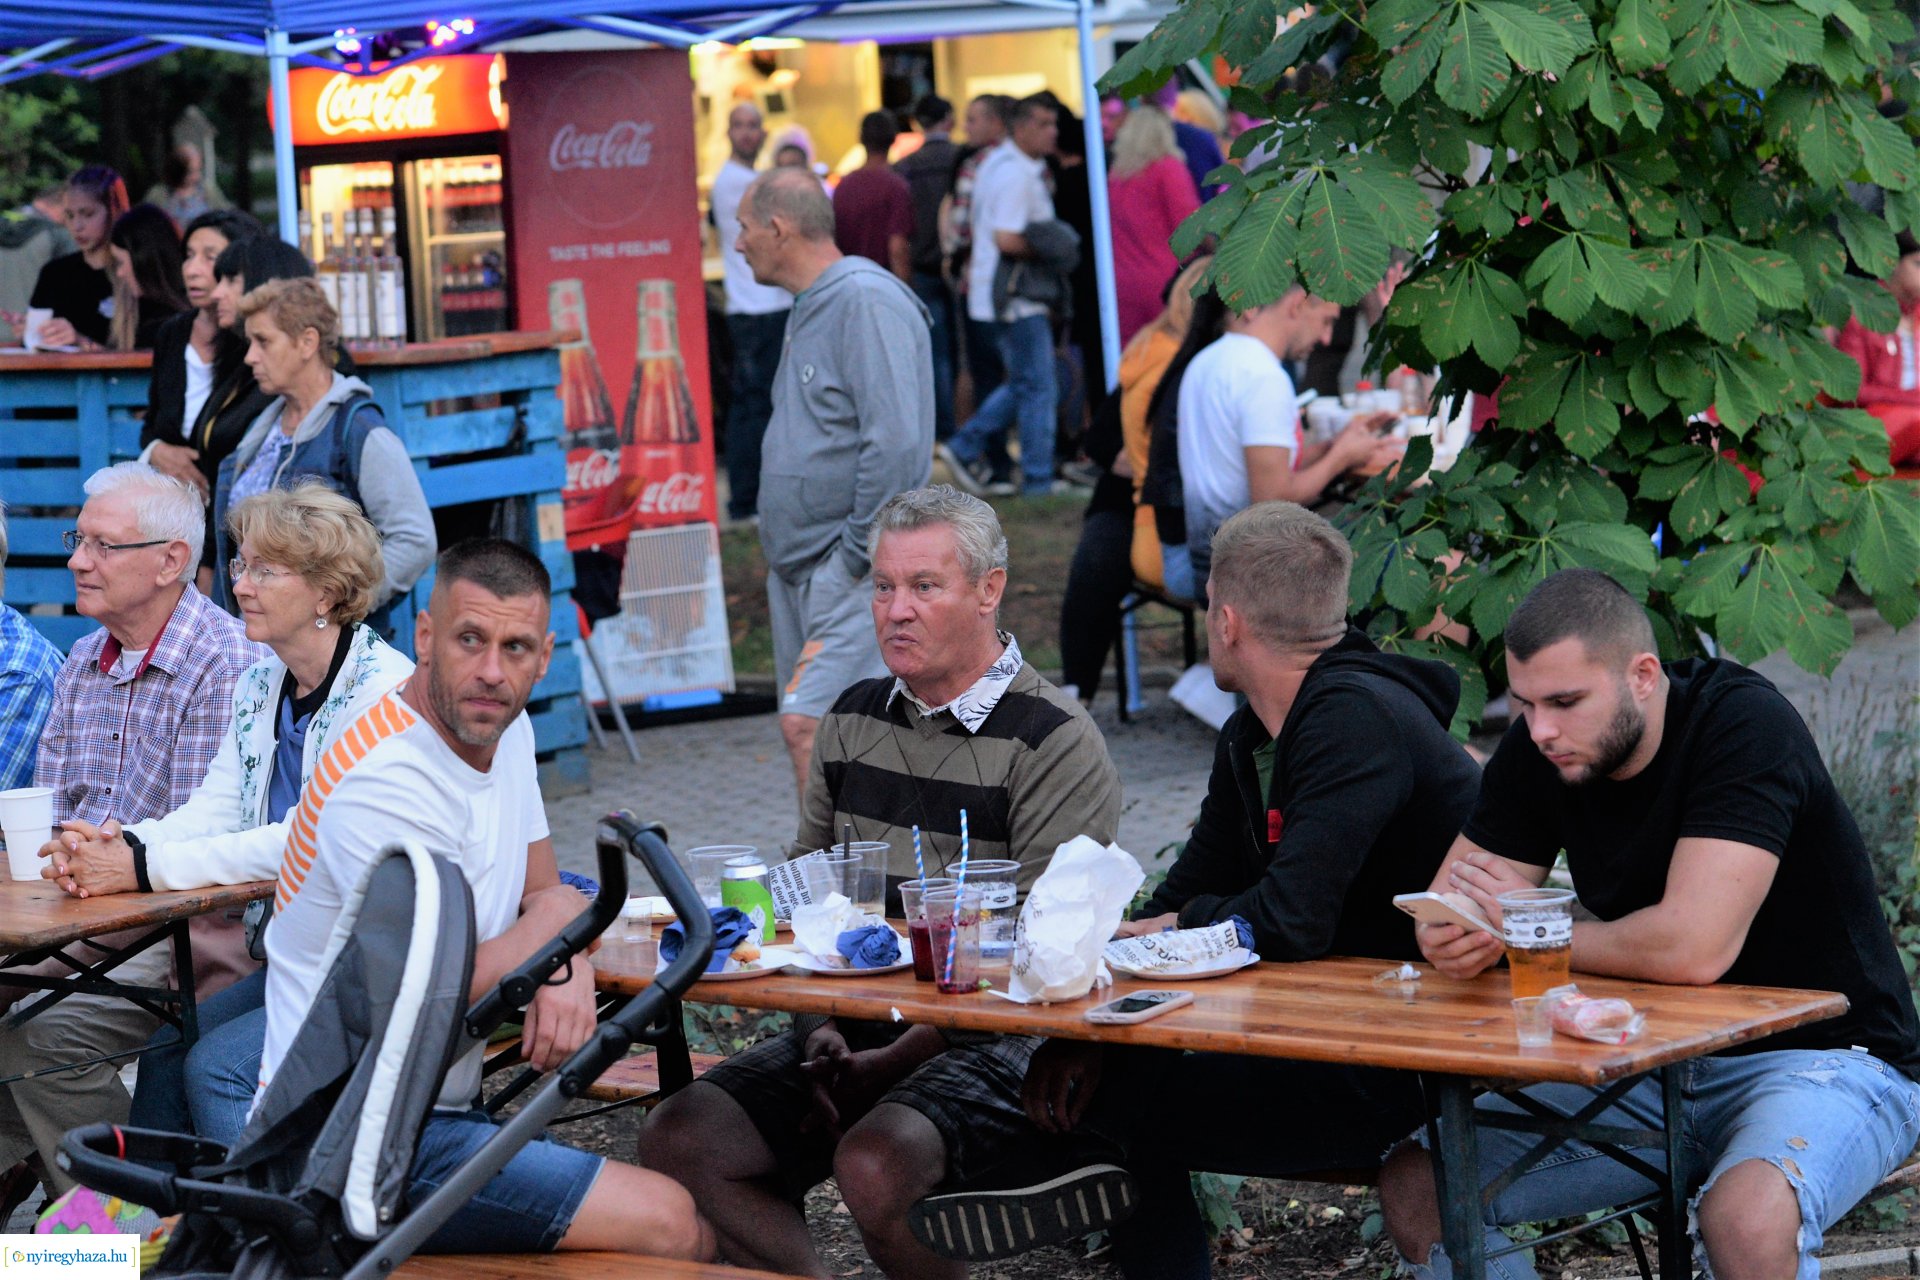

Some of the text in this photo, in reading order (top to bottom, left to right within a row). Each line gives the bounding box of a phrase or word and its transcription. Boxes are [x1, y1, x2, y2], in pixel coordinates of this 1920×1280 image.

[549, 239, 671, 261] TASTE THE FEELING
[769, 868, 779, 885] like
[777, 865, 800, 909] people toge
[788, 861, 807, 891] Nothing
[773, 886, 787, 905] good
